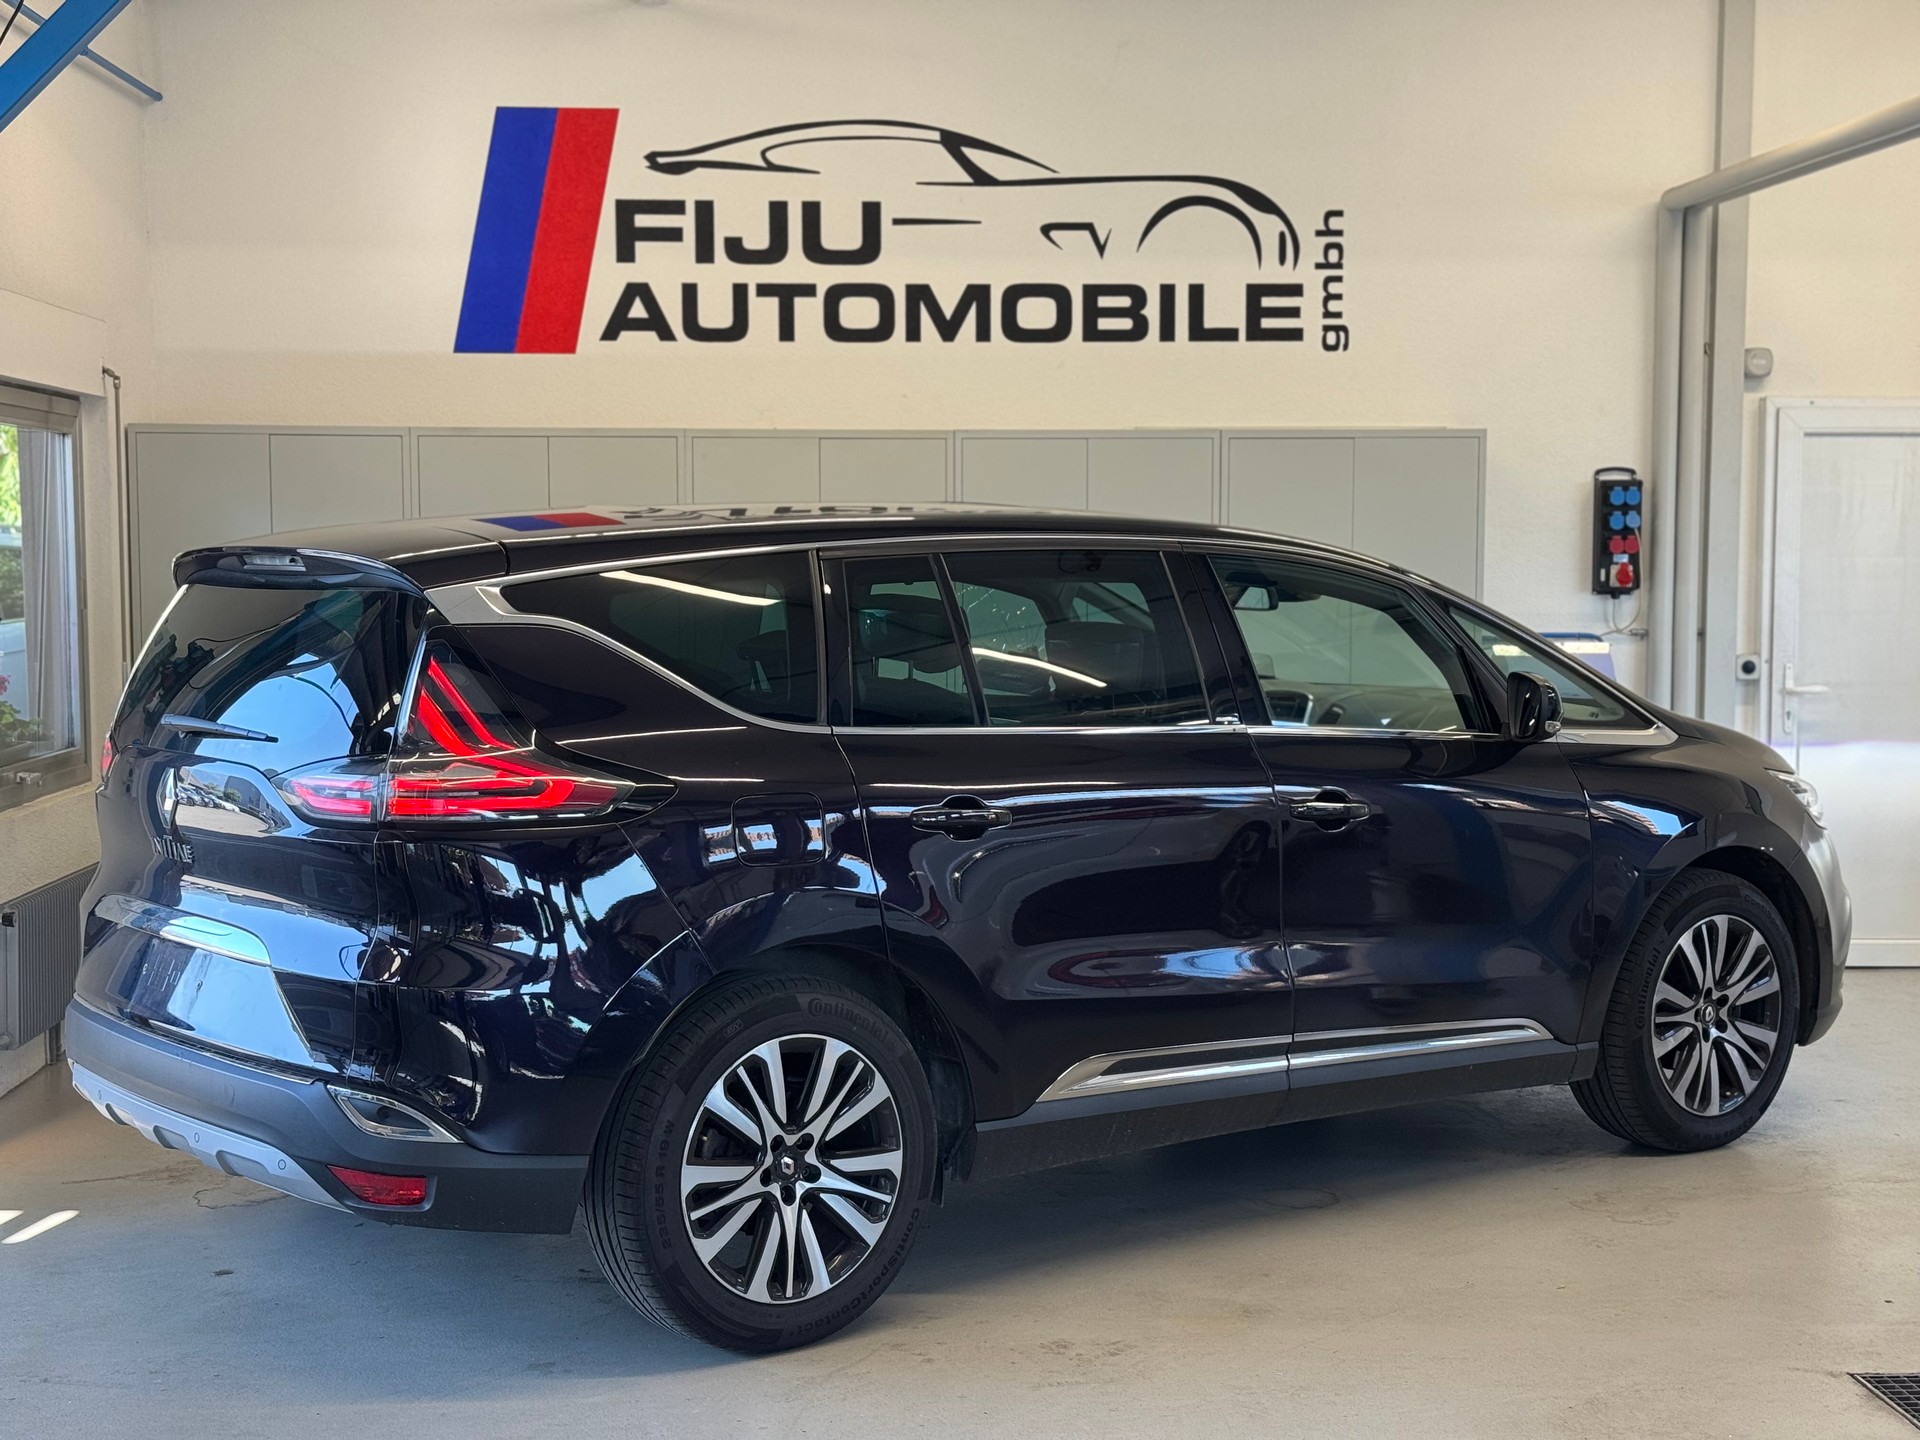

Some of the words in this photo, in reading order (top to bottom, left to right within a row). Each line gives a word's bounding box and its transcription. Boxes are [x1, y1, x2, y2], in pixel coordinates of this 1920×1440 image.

[615, 199, 881, 265] FIJU
[1315, 210, 1349, 353] gmbh
[599, 282, 1304, 343] AUTOMOBILE
[807, 997, 890, 1041] Continental
[657, 1139, 670, 1160] 19
[662, 1119, 676, 1136] W
[654, 1164, 666, 1178] R
